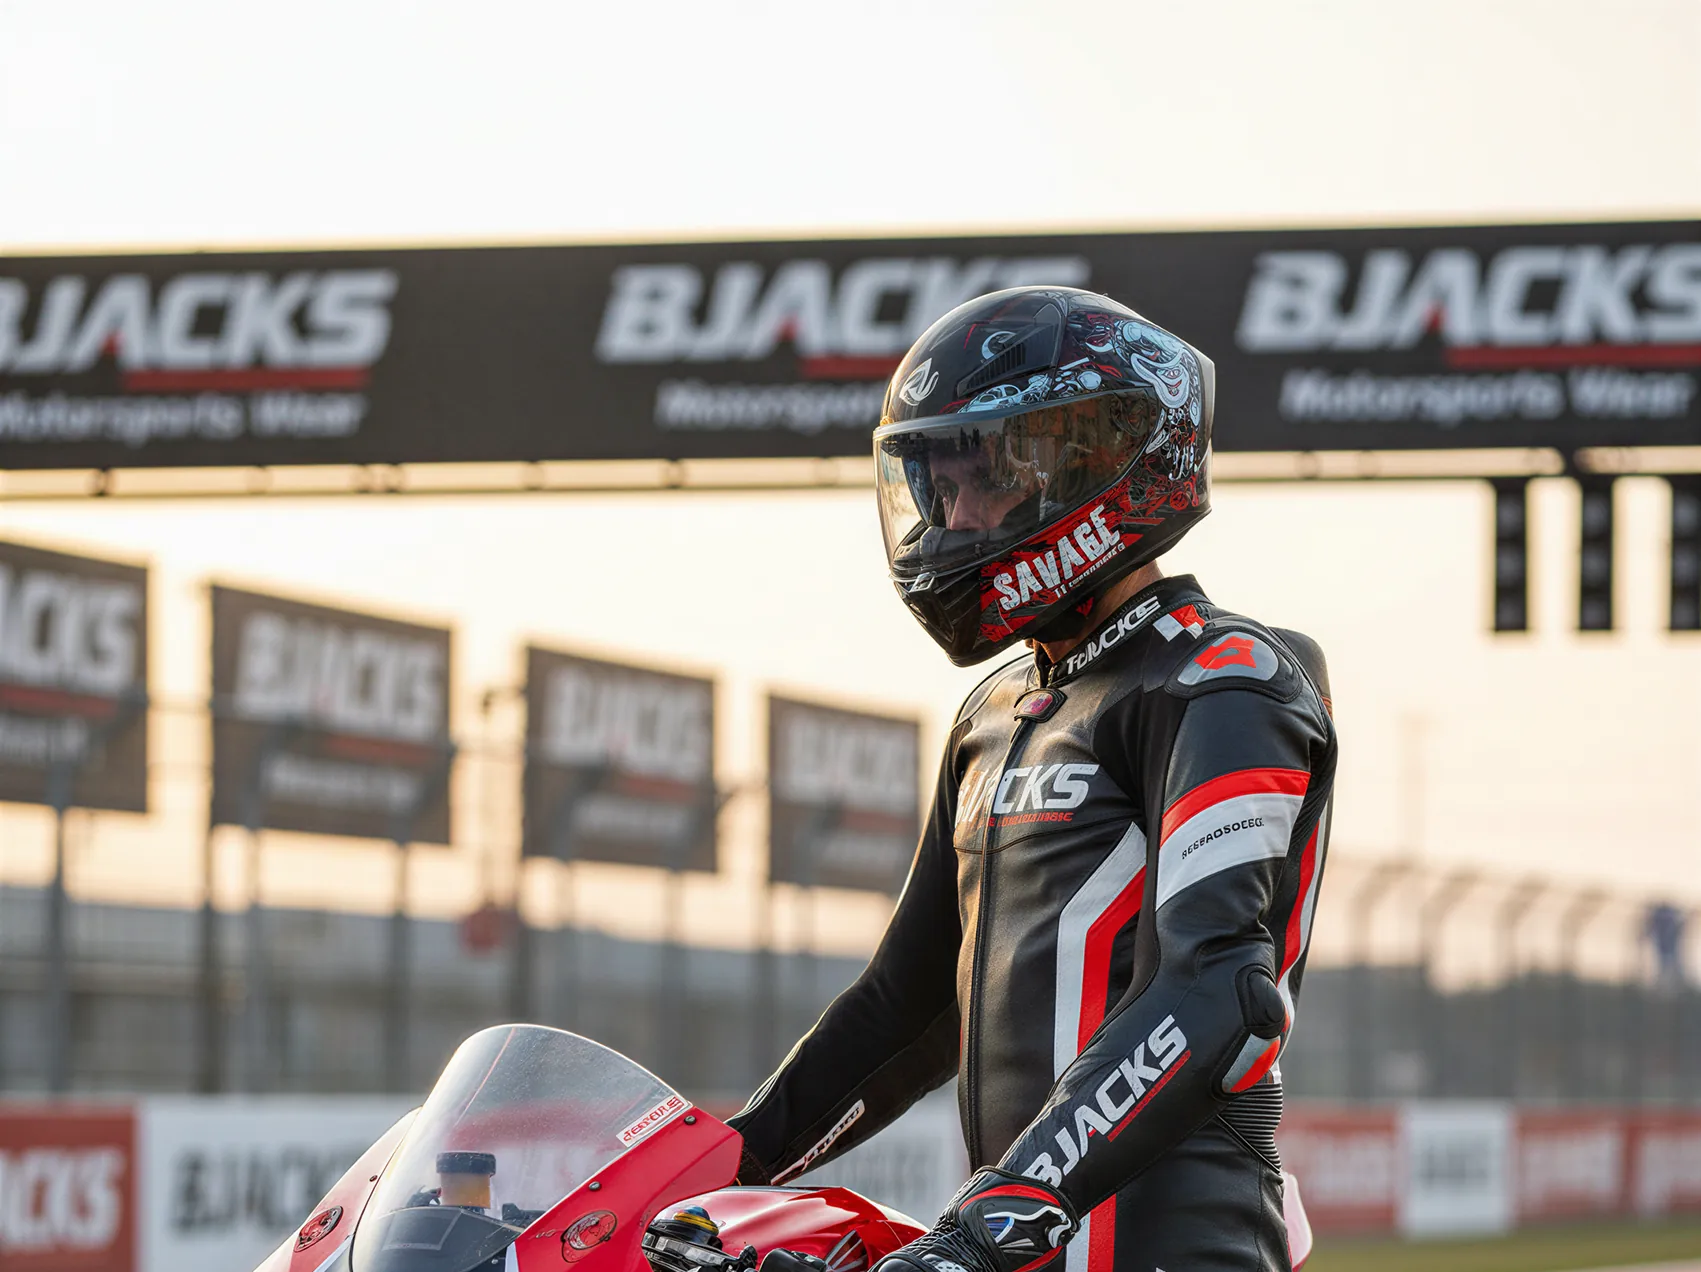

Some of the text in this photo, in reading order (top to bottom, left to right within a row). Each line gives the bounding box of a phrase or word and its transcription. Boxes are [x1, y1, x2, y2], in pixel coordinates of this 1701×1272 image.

[0, 272, 399, 373] JACKS
[594, 255, 1090, 364] BJACK
[993, 504, 1121, 611] SAVAGE
[1021, 1014, 1188, 1189] BJACKS
